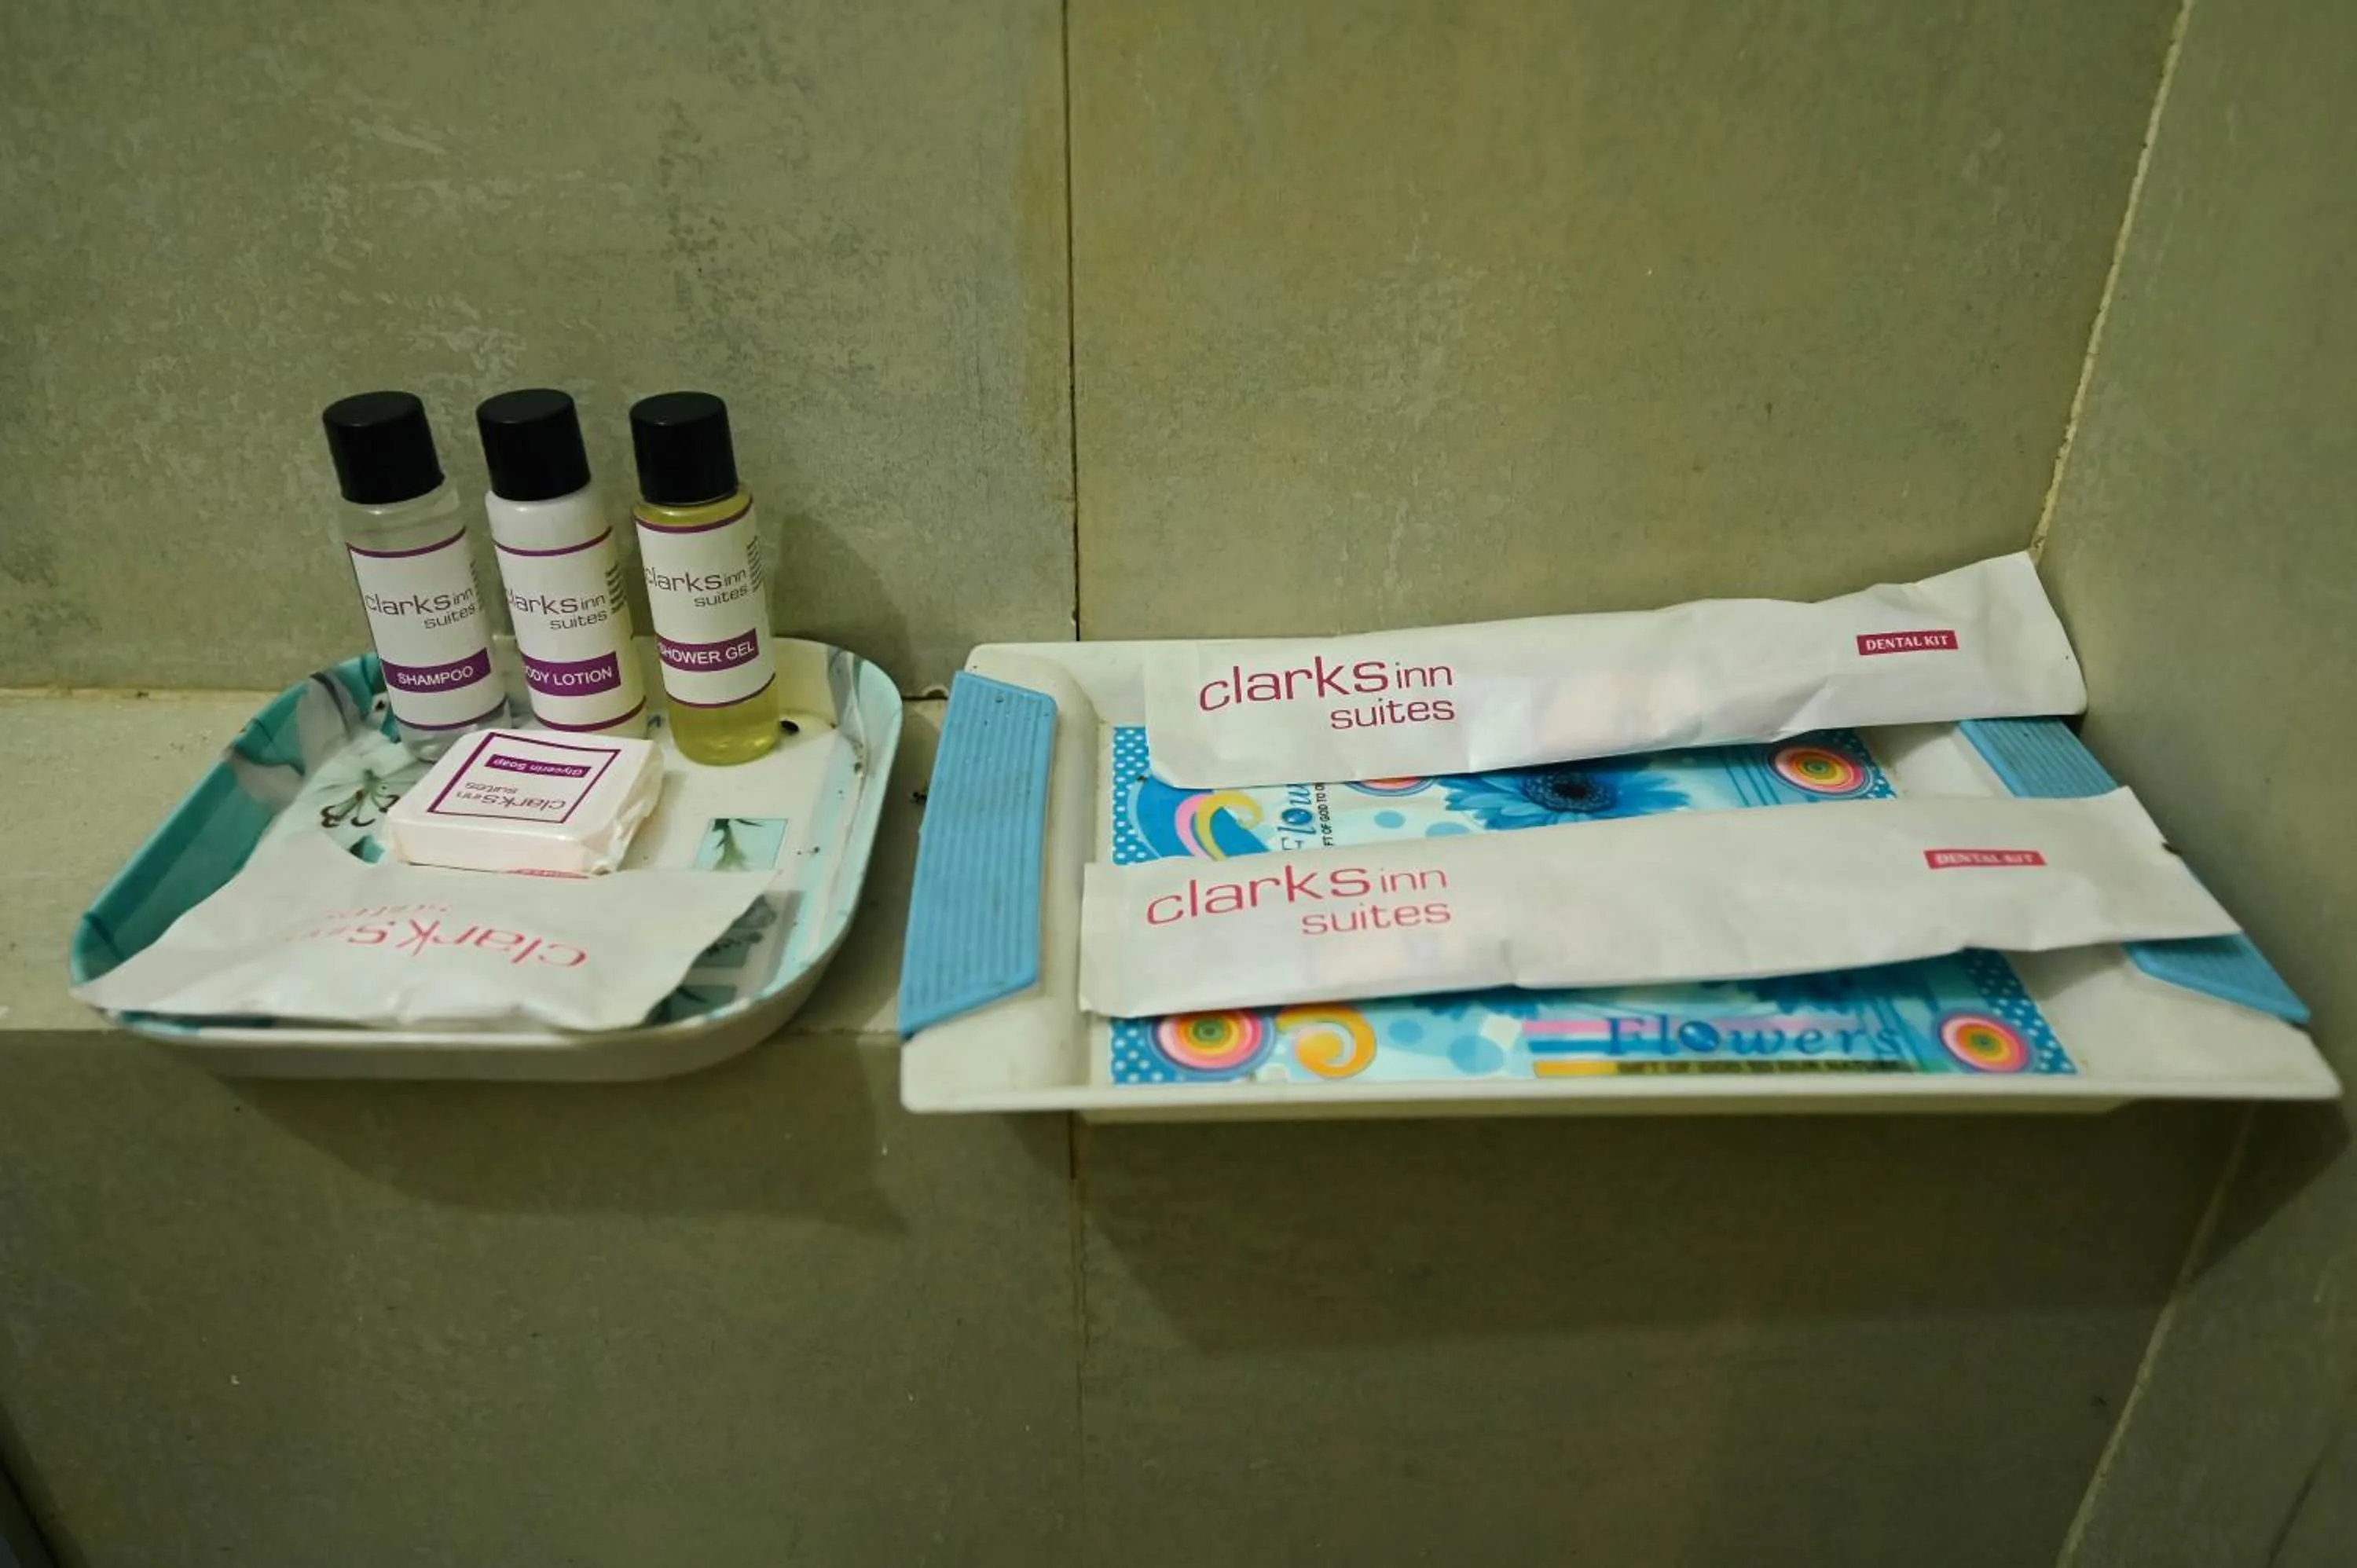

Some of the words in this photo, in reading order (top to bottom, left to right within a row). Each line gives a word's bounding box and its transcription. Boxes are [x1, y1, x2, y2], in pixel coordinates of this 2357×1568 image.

[724, 569, 746, 587] inn
[453, 588, 473, 605] inn
[581, 595, 606, 610] inn
[694, 585, 748, 607] suites
[423, 604, 476, 629] suites
[550, 610, 607, 630] suites
[725, 641, 754, 660] GEL
[1866, 636, 1923, 650] DENTAL
[1924, 636, 1948, 646] KIT
[397, 665, 474, 686] SHAMPOO
[554, 666, 612, 686] LOTION
[1199, 655, 1389, 712] clarks
[1395, 662, 1453, 689] inn
[1330, 698, 1454, 730] suites
[493, 757, 526, 771] Soap
[530, 764, 583, 776] Glycerin
[482, 795, 566, 811] clarks
[1146, 865, 1371, 925] clarks
[1380, 867, 1447, 893] inn
[1302, 902, 1451, 935] suites
[347, 919, 586, 966] clarks
[1604, 1014, 1902, 1058] Flowers
